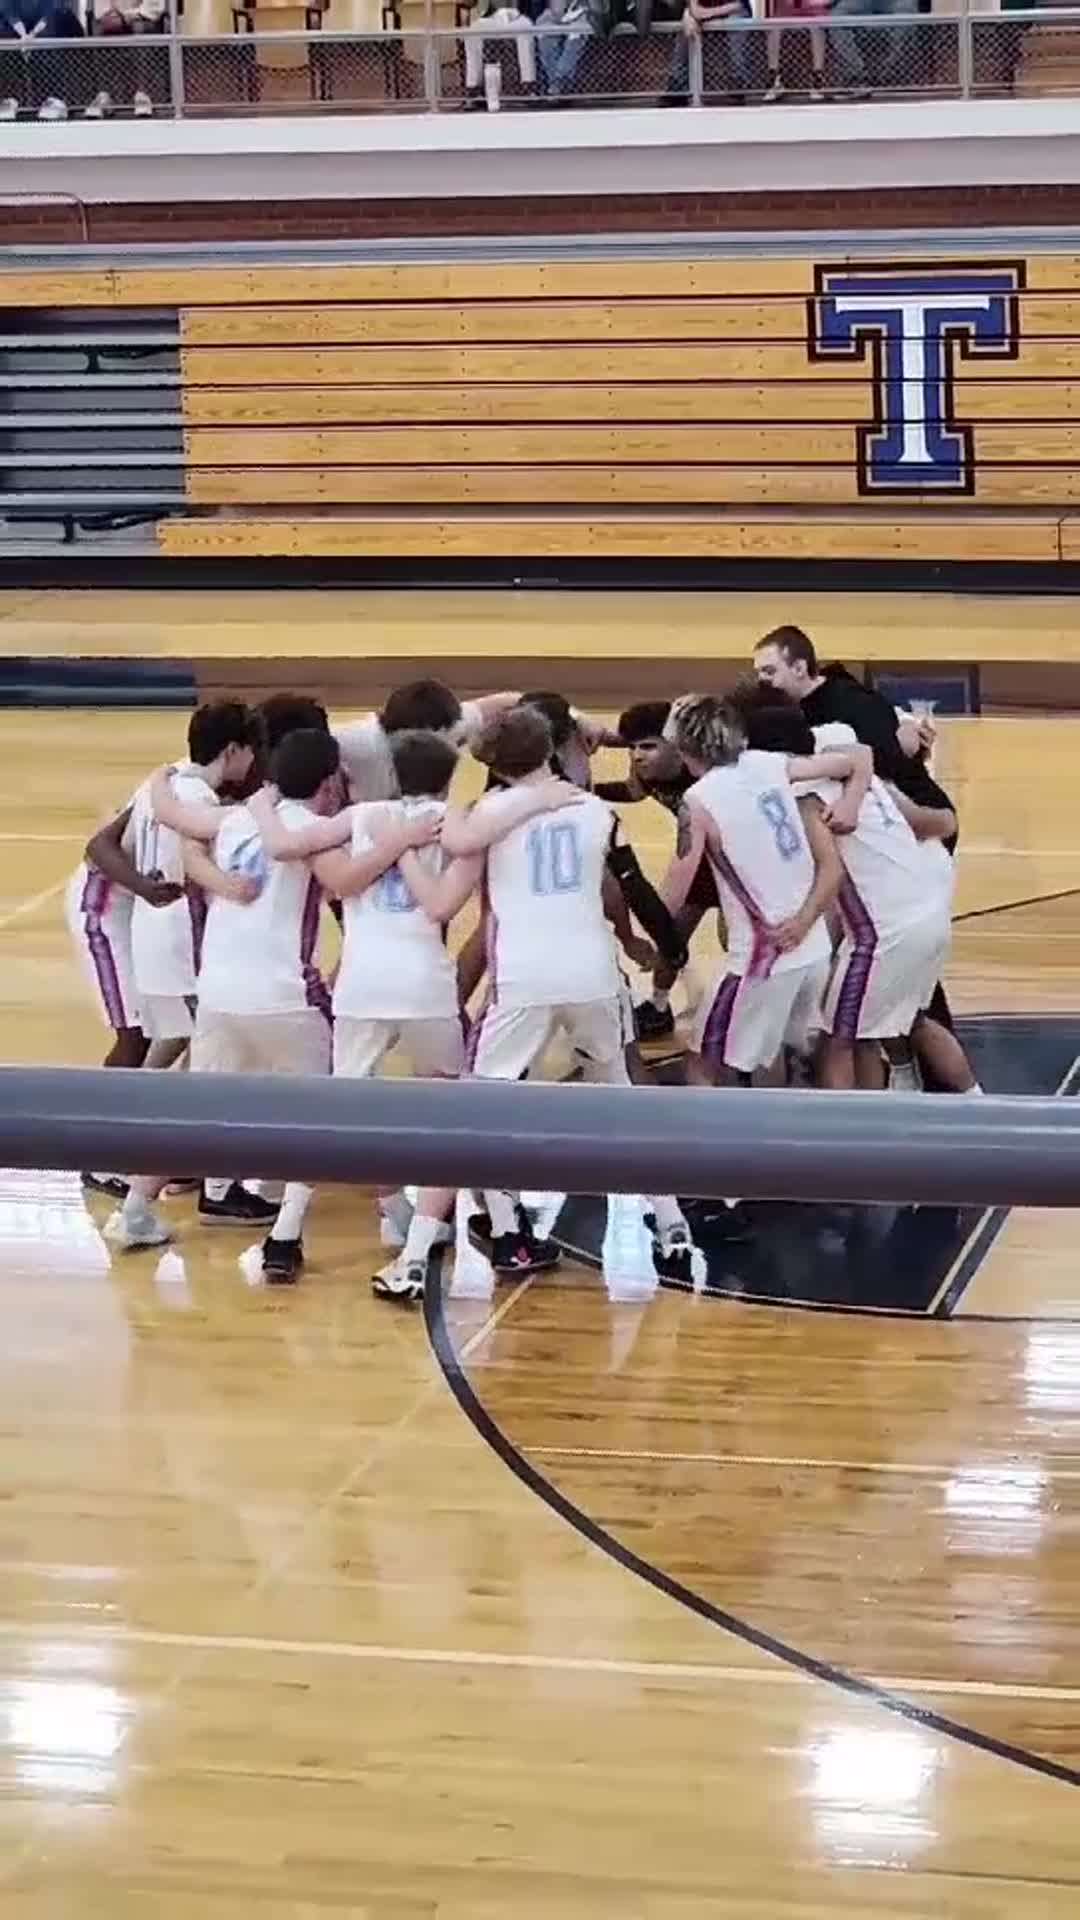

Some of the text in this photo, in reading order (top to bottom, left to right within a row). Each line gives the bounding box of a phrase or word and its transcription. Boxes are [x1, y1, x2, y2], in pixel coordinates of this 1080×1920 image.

[806, 260, 1026, 496] T
[526, 821, 584, 896] 10
[759, 789, 800, 860] 8
